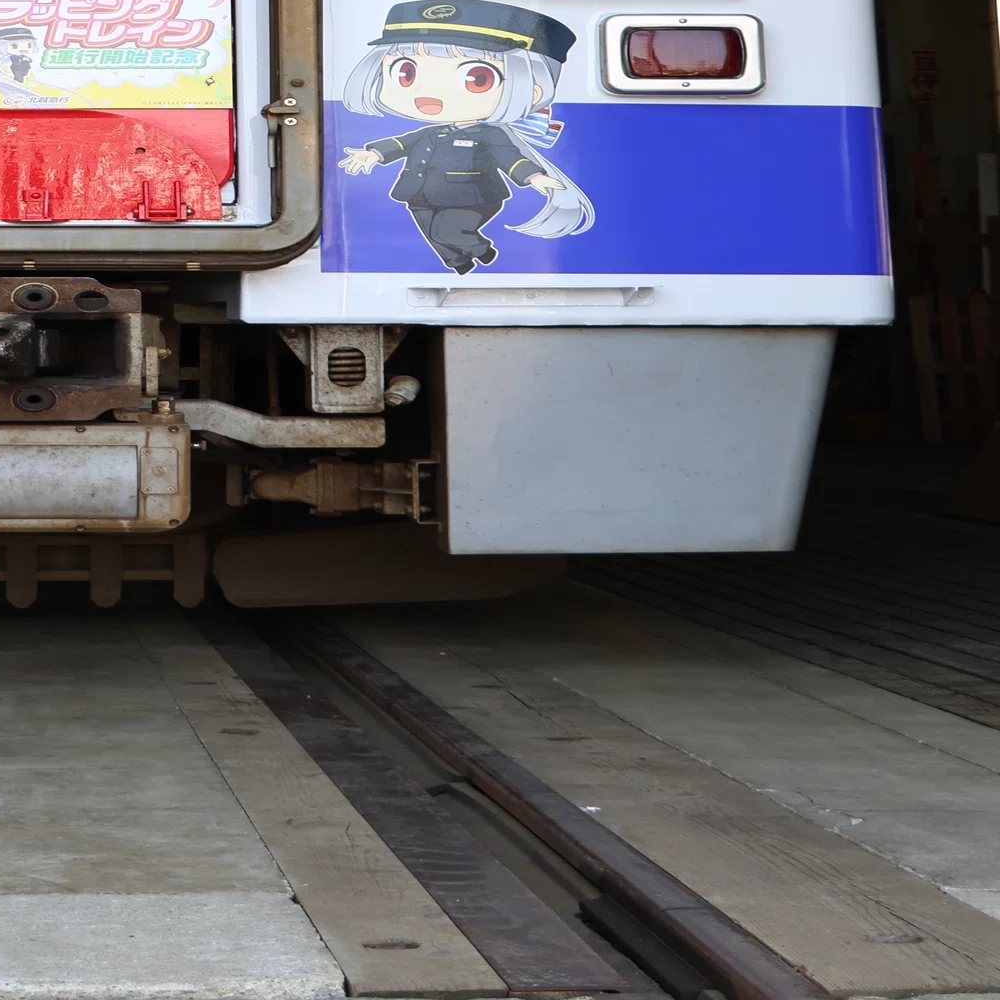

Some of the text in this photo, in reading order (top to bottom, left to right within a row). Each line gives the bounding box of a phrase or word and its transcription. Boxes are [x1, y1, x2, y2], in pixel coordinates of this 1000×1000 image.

[51, 19, 210, 45] トレイン
[48, 49, 200, 65] 運行開始記念
